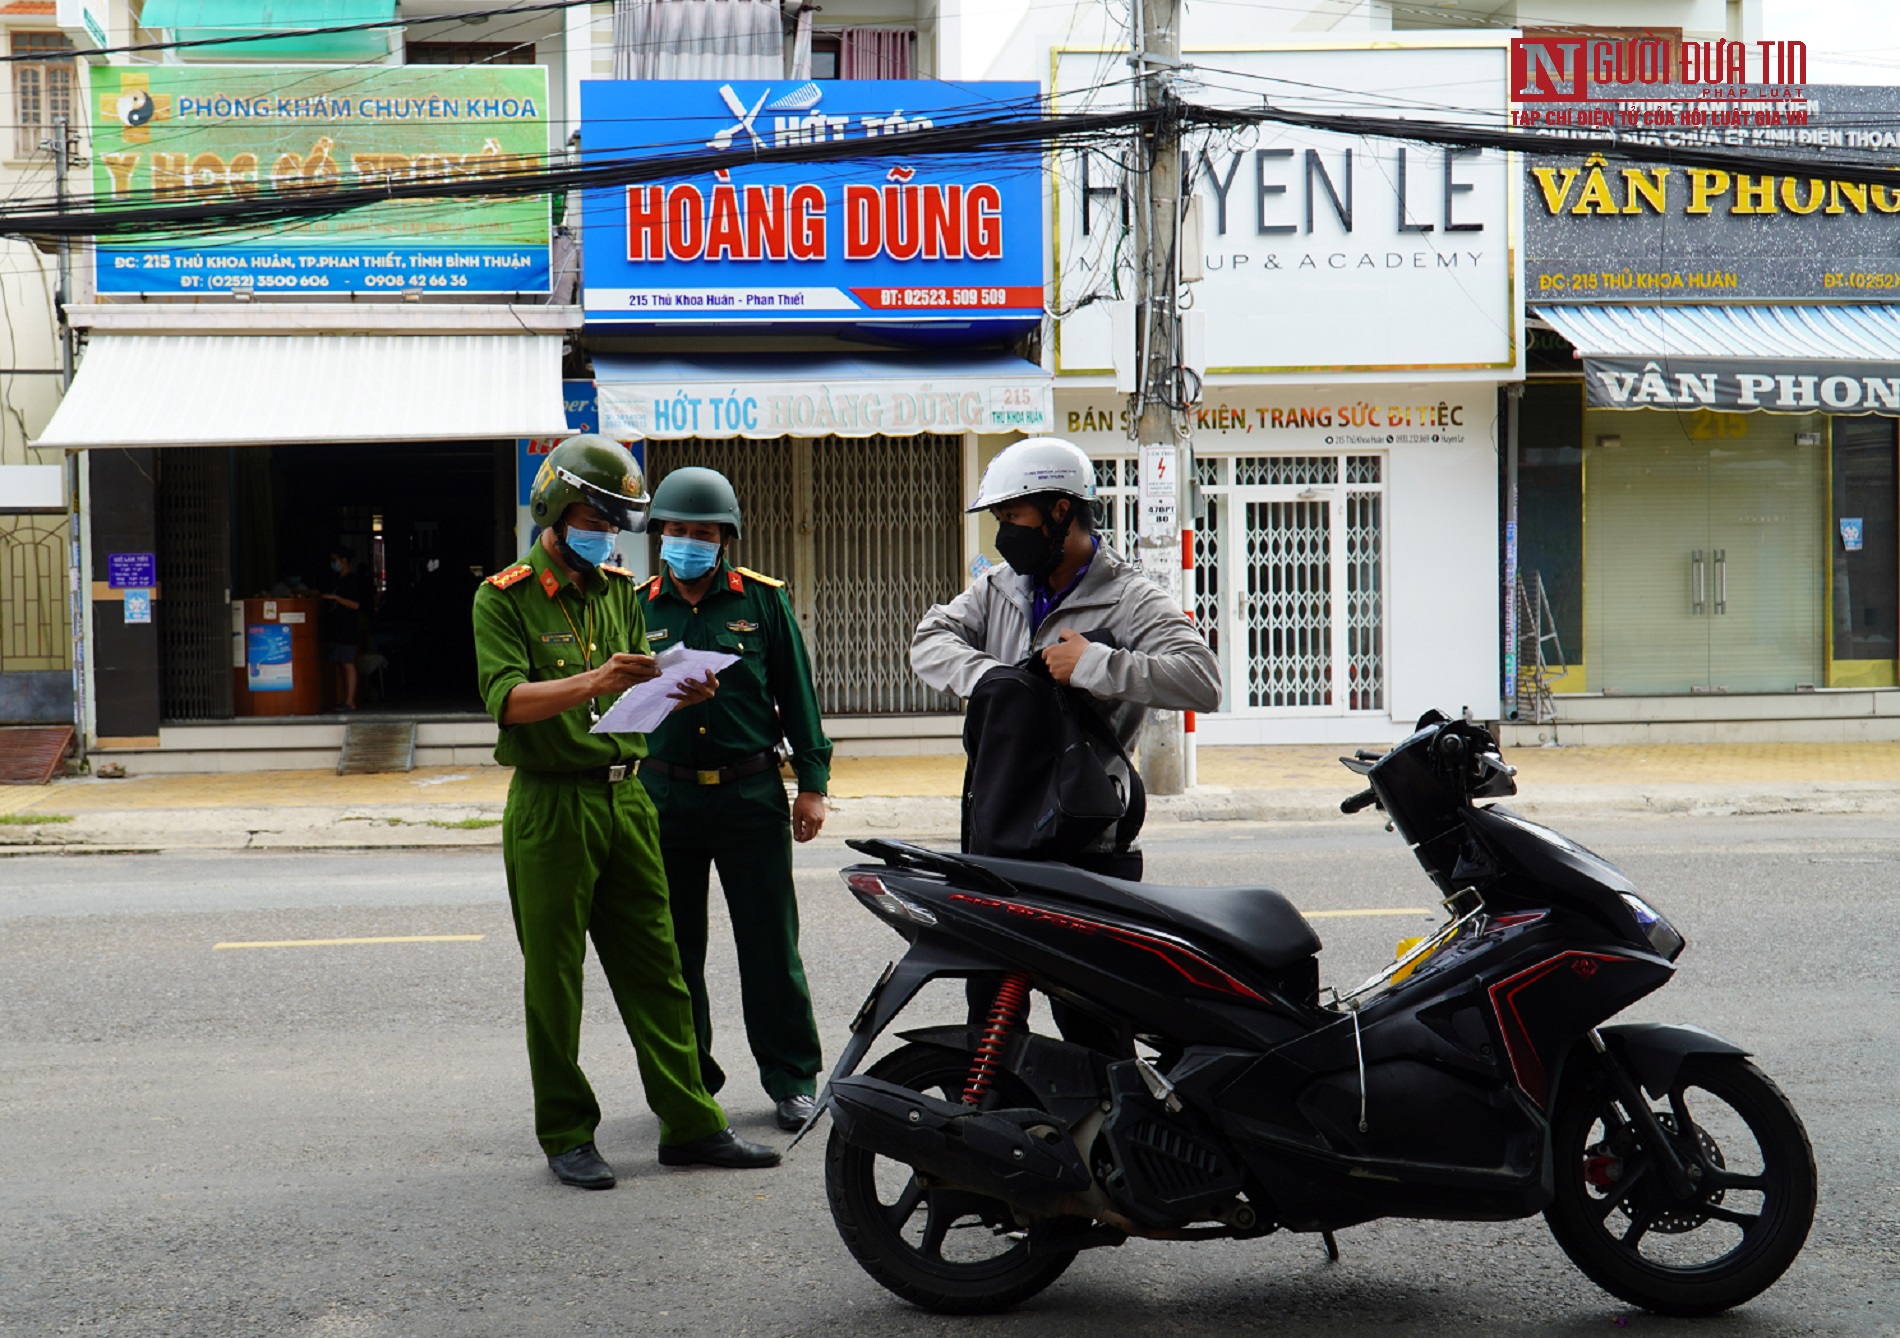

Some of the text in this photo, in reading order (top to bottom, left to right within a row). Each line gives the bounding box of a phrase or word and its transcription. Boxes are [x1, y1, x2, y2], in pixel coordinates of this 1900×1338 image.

[179, 92, 538, 120] PHÒNG KHÁM CHUYÊN KHOA
[773, 109, 849, 148] HỚT
[101, 152, 142, 200] Y
[1082, 146, 1486, 236] HYEN LE
[1533, 152, 1671, 214] VÂN
[626, 166, 1003, 262] HOÀNG DŨNG
[115, 256, 139, 269] ĐC:
[143, 255, 170, 269] 215
[174, 253, 203, 268] THỦ
[206, 256, 248, 268] KHOA
[1299, 252, 1483, 271] ACADEMY
[207, 274, 254, 290] (0252)
[257, 275, 296, 287] 3500
[300, 275, 330, 287] 606
[364, 275, 405, 287] 0908
[408, 275, 427, 287] 42
[428, 275, 447, 287] 66
[450, 275, 468, 287] 36
[1602, 267, 1634, 289] THỦ
[1637, 274, 1683, 288] KHOA
[1688, 270, 1738, 288] HUÂN
[629, 294, 648, 306] 215
[651, 293, 672, 306] Thủ
[675, 294, 703, 306] Khoa
[746, 294, 774, 306] Phan
[881, 289, 902, 306] ĐT:
[953, 289, 978, 305] 509
[981, 289, 1006, 305] 509
[1004, 388, 1031, 405] 215
[1596, 361, 1718, 404] VÂN
[654, 389, 703, 431] HỚT
[709, 389, 758, 431] TÓC
[766, 384, 884, 429] HOÀNG
[892, 384, 984, 426] DŨNG
[1068, 406, 1113, 432] BÁN
[1197, 404, 1253, 433] KIỆN,
[1256, 406, 1332, 429] TRANG
[1337, 401, 1381, 427] SỨC
[1387, 406, 1411, 427] ĐI
[1415, 402, 1463, 432] TIỆC
